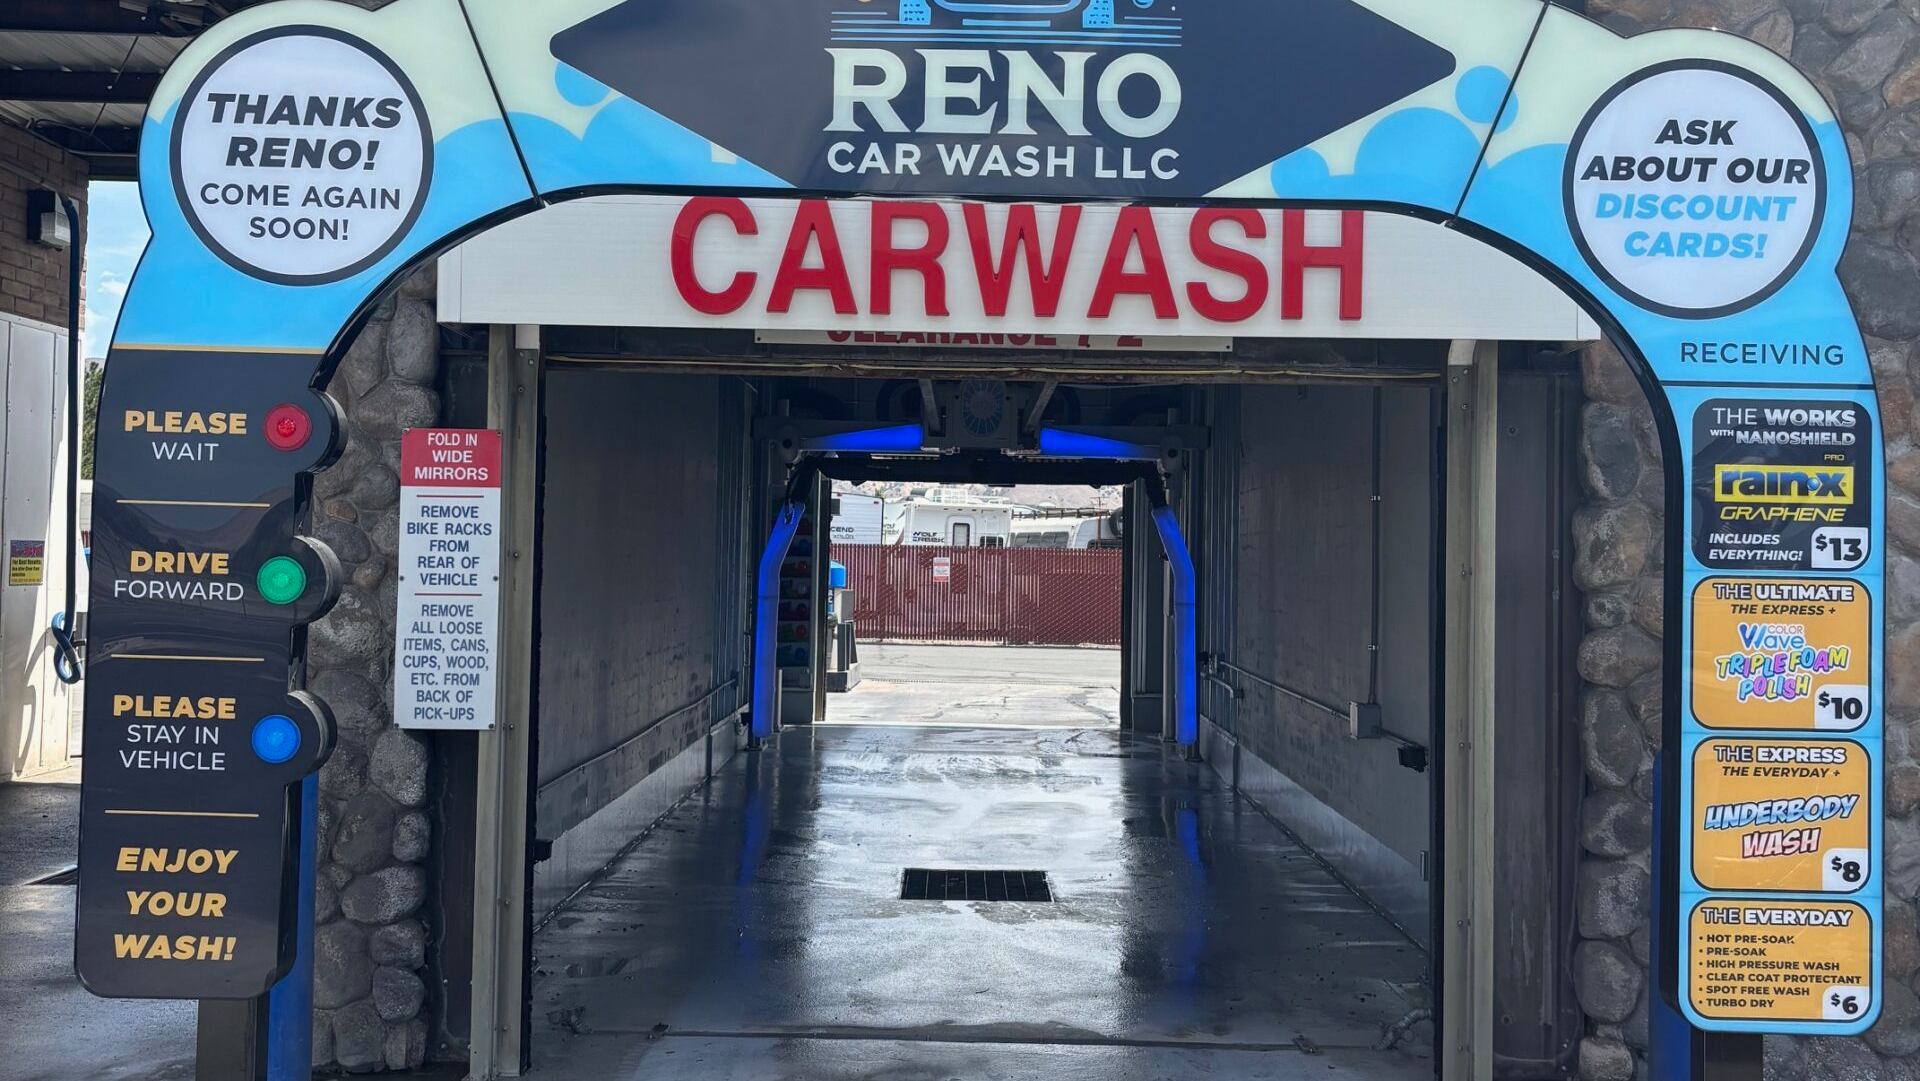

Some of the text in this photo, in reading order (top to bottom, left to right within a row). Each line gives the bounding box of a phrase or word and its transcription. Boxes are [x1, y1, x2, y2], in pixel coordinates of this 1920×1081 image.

[823, 47, 1183, 137] RENO
[207, 92, 404, 129] THANKS
[1654, 119, 1738, 146] ASK
[225, 136, 380, 171] RENO!
[827, 141, 1180, 180] CAR WASH LLC
[1580, 155, 1811, 185] ABOUT OUR
[200, 183, 400, 210] COME AGAIN
[1595, 193, 1797, 222] DISCOUNT
[249, 216, 349, 241] SOON!
[1623, 231, 1768, 259] CARDS!
[670, 196, 1365, 322] CARWASH
[1680, 342, 1844, 366] RECEIVING
[124, 410, 248, 435] PLEASE
[1712, 407, 1857, 427] THE WORKS
[427, 432, 478, 447] FOLD IN
[1710, 429, 1856, 446] WITH NANOSHIELD
[151, 441, 219, 462] WAIT
[432, 450, 473, 464] WIDE
[1823, 453, 1846, 461] PRO
[414, 466, 489, 481] MIRRORS
[420, 506, 480, 519] REMOVE
[1720, 506, 1847, 522] GRAPHENE
[407, 522, 493, 536] BIKE RACKS
[1709, 533, 1780, 545] INCLUDES
[429, 539, 469, 552] FROM
[1709, 549, 1803, 561] EVERYTHING!
[1815, 534, 1863, 561] $13
[130, 550, 230, 575] DRIVE
[417, 556, 480, 570] REAR OF
[419, 572, 478, 586] VEHICLE
[114, 580, 244, 602] FORWARD
[1713, 583, 1854, 602] THE ULTIMATE
[421, 604, 474, 617] REMOVE
[1731, 604, 1758, 614] THE
[1761, 605, 1825, 615] EXPRESS
[411, 621, 483, 635] ALL LOOSE
[1739, 624, 1805, 649] Wave
[1767, 625, 1804, 635] COLOR
[403, 638, 490, 654] ITEMS, CANS,
[402, 655, 490, 672] CUPS, WOOD,
[1716, 647, 1849, 678] TRIPLE FOAM
[410, 672, 480, 686] ETC. FROM
[1739, 674, 1811, 701] POLISH
[416, 689, 473, 703] BACK OF
[1818, 691, 1863, 720] $10
[112, 694, 236, 720] PLEASE
[413, 707, 475, 720] PICK-UPS
[127, 724, 219, 745] STAY IN
[119, 750, 225, 771] VEHICLE
[1713, 745, 1847, 764] THE EXPRESS
[1722, 766, 1749, 777] THE
[1753, 767, 1829, 778] EVERYDAY
[1704, 795, 1860, 830] UNDERBODY
[1742, 827, 1821, 859] WASH
[116, 847, 238, 874] ENJOY
[1831, 856, 1861, 883] $8
[126, 890, 227, 917] YOUR
[1701, 906, 1853, 927] THE EVERYDAY
[114, 934, 237, 961] WASH!
[1706, 934, 1795, 944] HOT PRE-SOAK
[1706, 947, 1767, 957] PRE-SOAK
[1706, 960, 1840, 971] HIGH PRESSURE WASH
[1706, 972, 1862, 985] CLEAR COAT PROTECTANT
[1706, 985, 1810, 996] SPOT FREE WASH
[1706, 998, 1775, 1008] TURBO DRY
[1830, 992, 1859, 1015] $6
